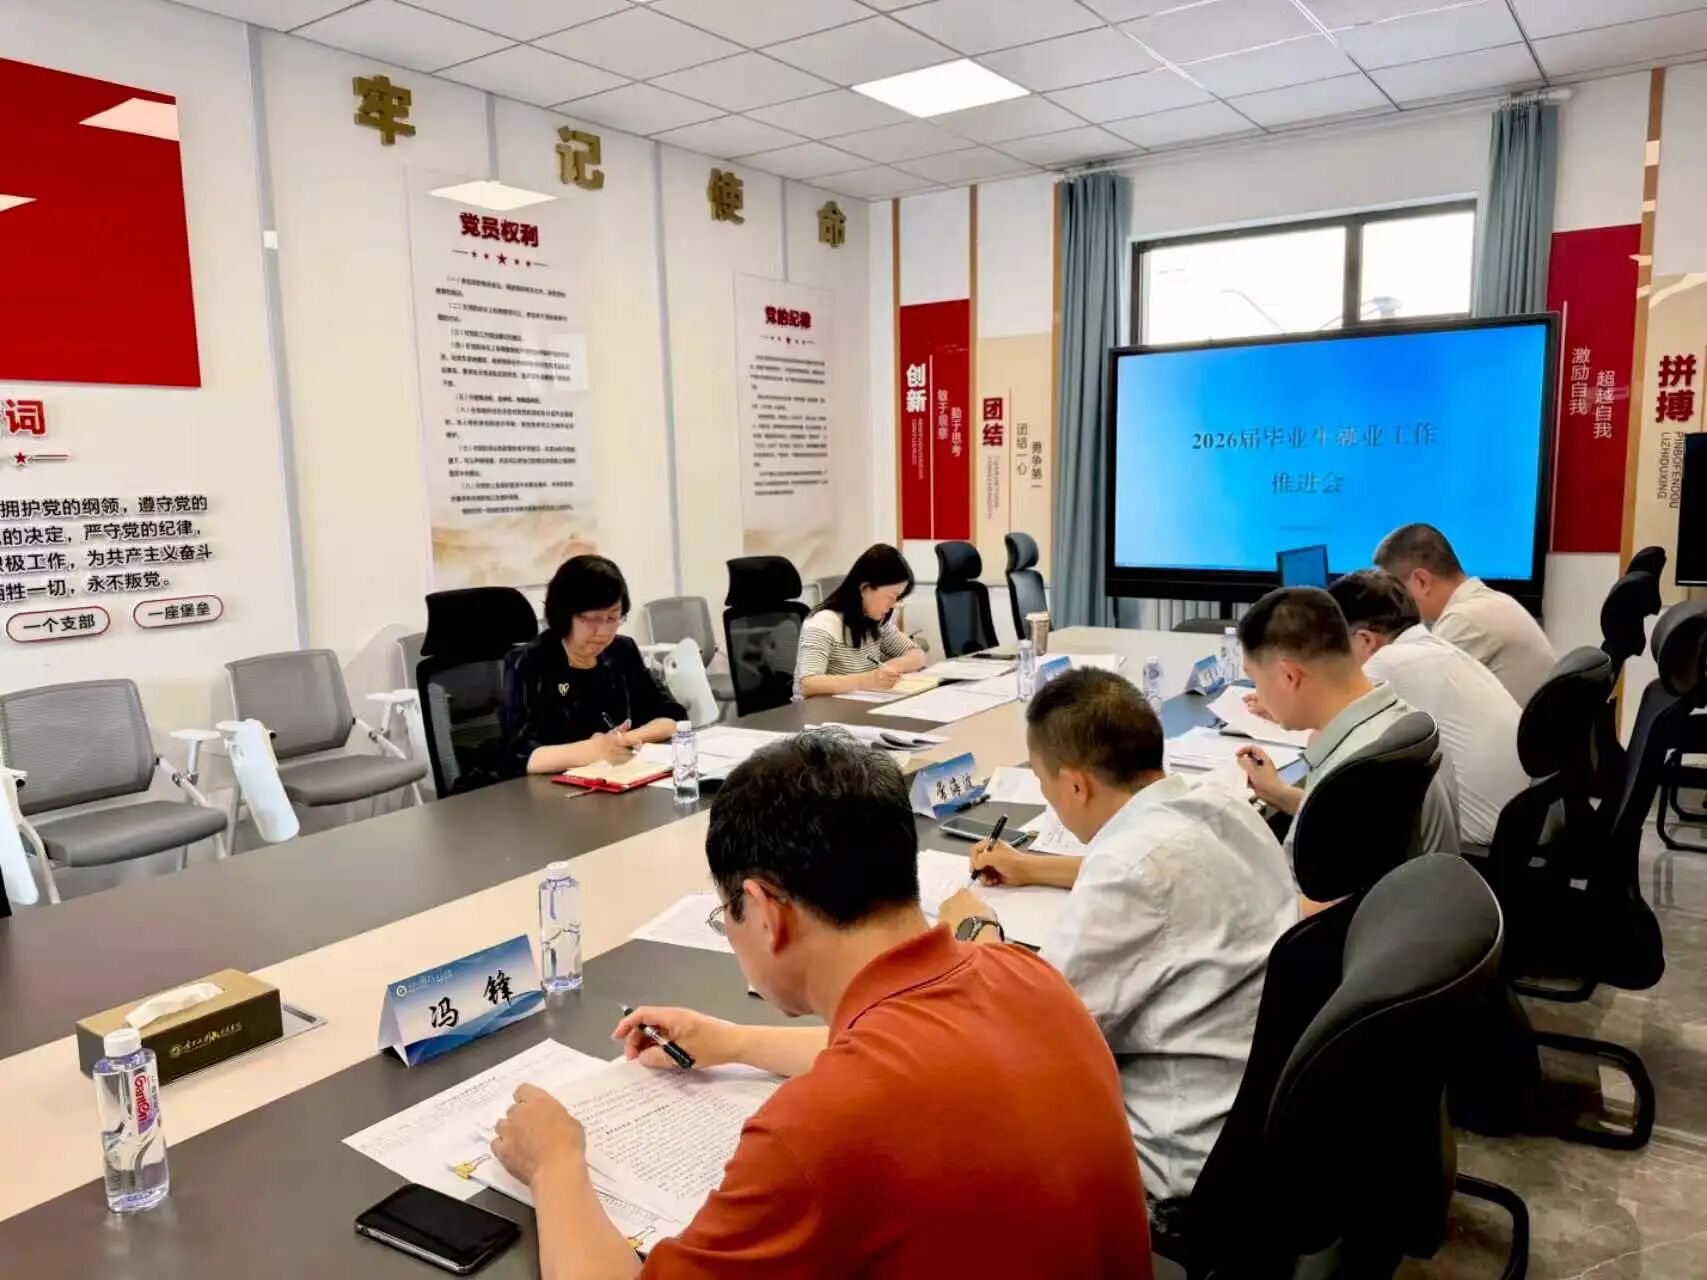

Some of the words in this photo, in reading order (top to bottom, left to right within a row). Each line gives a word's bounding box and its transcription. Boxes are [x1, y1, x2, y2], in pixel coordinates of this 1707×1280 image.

[352, 75, 416, 146] 牢
[555, 125, 605, 190] 记
[708, 168, 745, 225] 使
[816, 201, 847, 249] 命
[459, 212, 539, 247] 党员权利
[906, 363, 927, 412] 创新
[1568, 346, 1591, 415] 激励自我
[1656, 354, 1696, 423] 拼搏
[6, 399, 47, 436] 词
[982, 397, 1004, 447] 团结
[1593, 370, 1615, 439] 超越自我
[1016, 423, 1028, 476] 团结一心
[1191, 421, 1439, 451] 2026届毕业生就业工作
[1271, 471, 1344, 495] 推进会
[0, 520, 202, 546] 的决定，严守党的纪律，
[0, 543, 213, 573] 极工作，为共产主义奋斗
[23, 614, 95, 633] 一个支部
[148, 603, 211, 620] 一座堡垒
